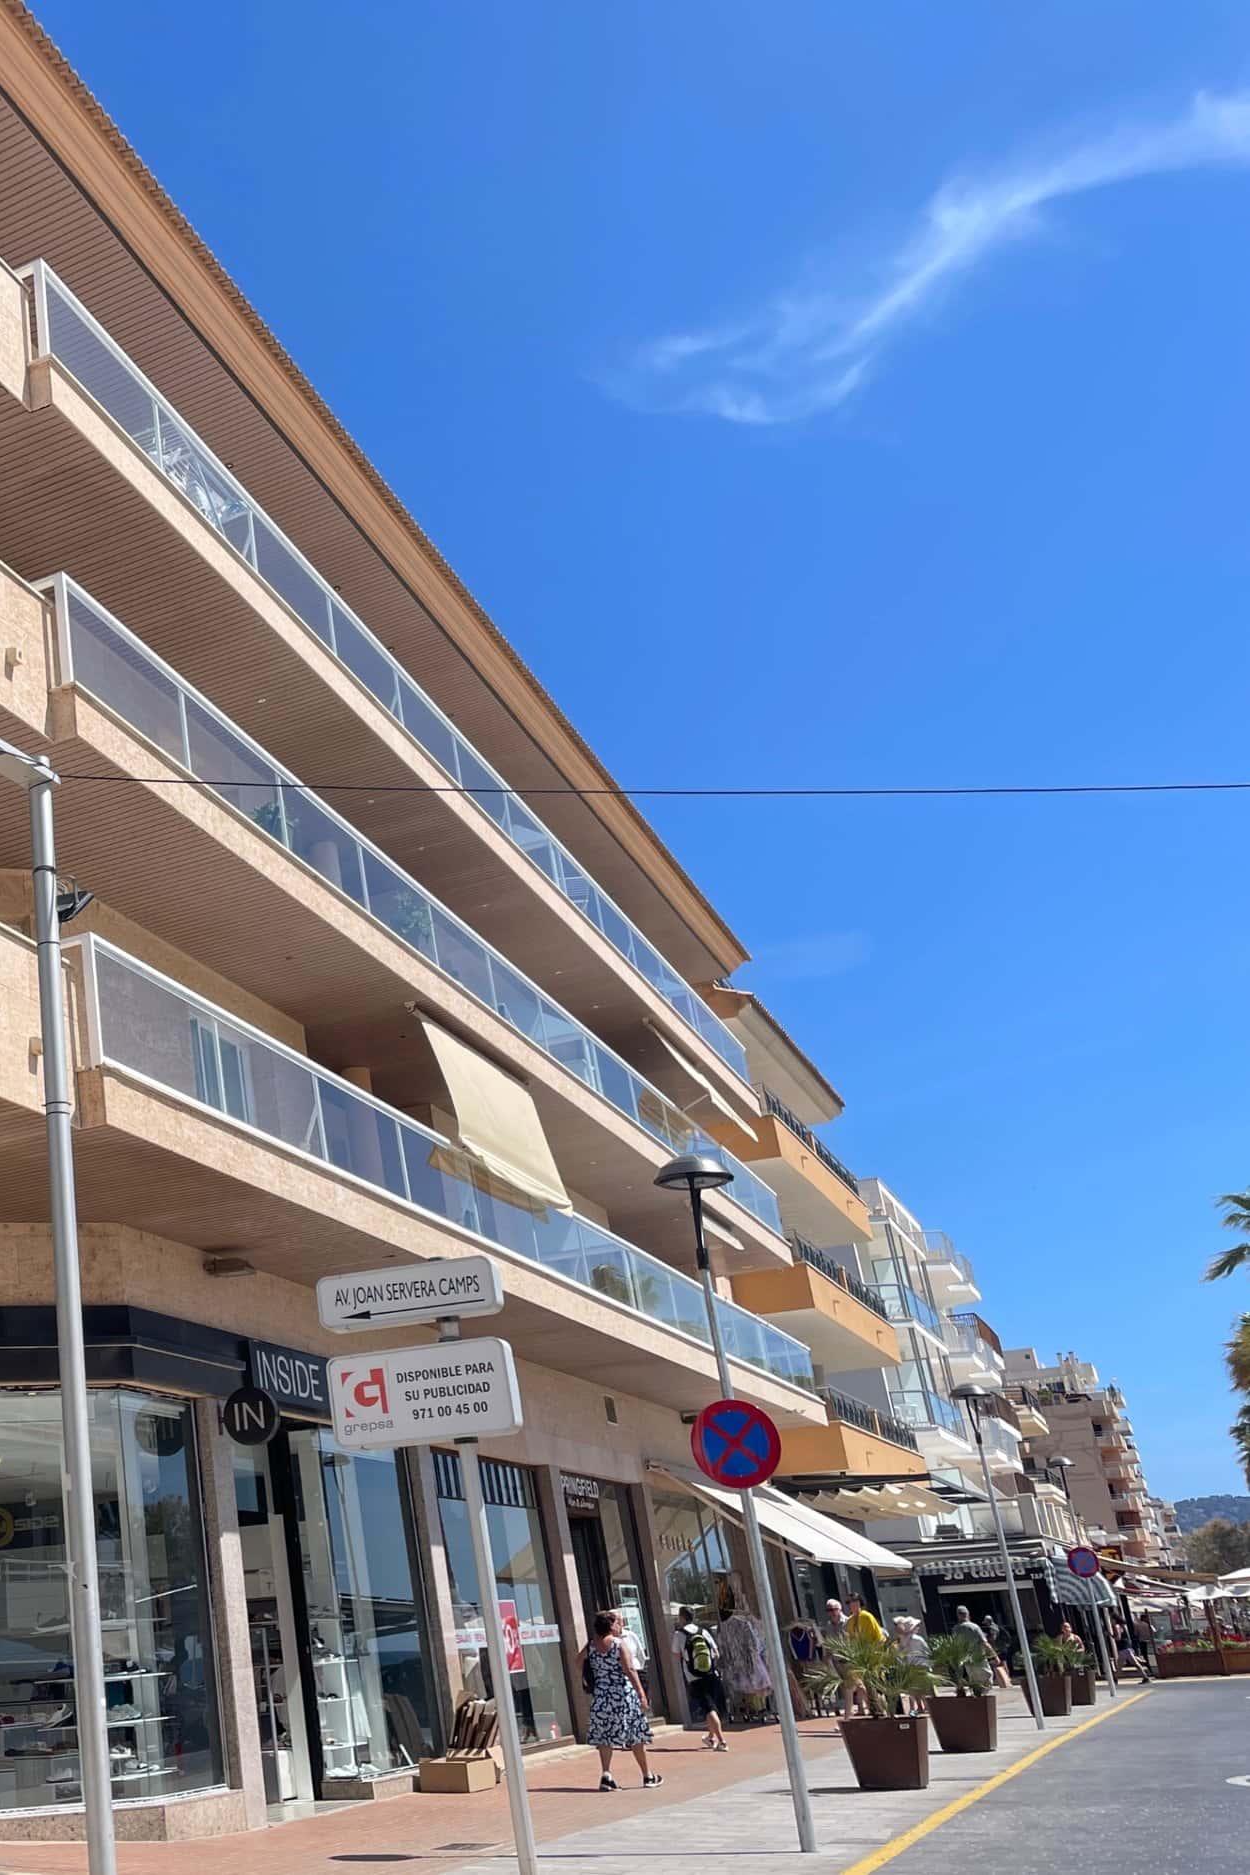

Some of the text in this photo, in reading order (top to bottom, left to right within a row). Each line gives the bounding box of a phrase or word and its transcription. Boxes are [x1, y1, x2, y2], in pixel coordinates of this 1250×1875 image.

[335, 1275, 480, 1310] AV. JOAN SERVERA CAMPS
[256, 1350, 323, 1402] INSIDE
[396, 1361, 494, 1384] DISPONIBLE PARA
[404, 1381, 491, 1402] SU PUBLICIDAD
[233, 1400, 265, 1431] IN
[412, 1400, 489, 1420] 971 00 45 00
[344, 1418, 394, 1436] grepsa
[559, 1475, 599, 1499] PRINGFIELD
